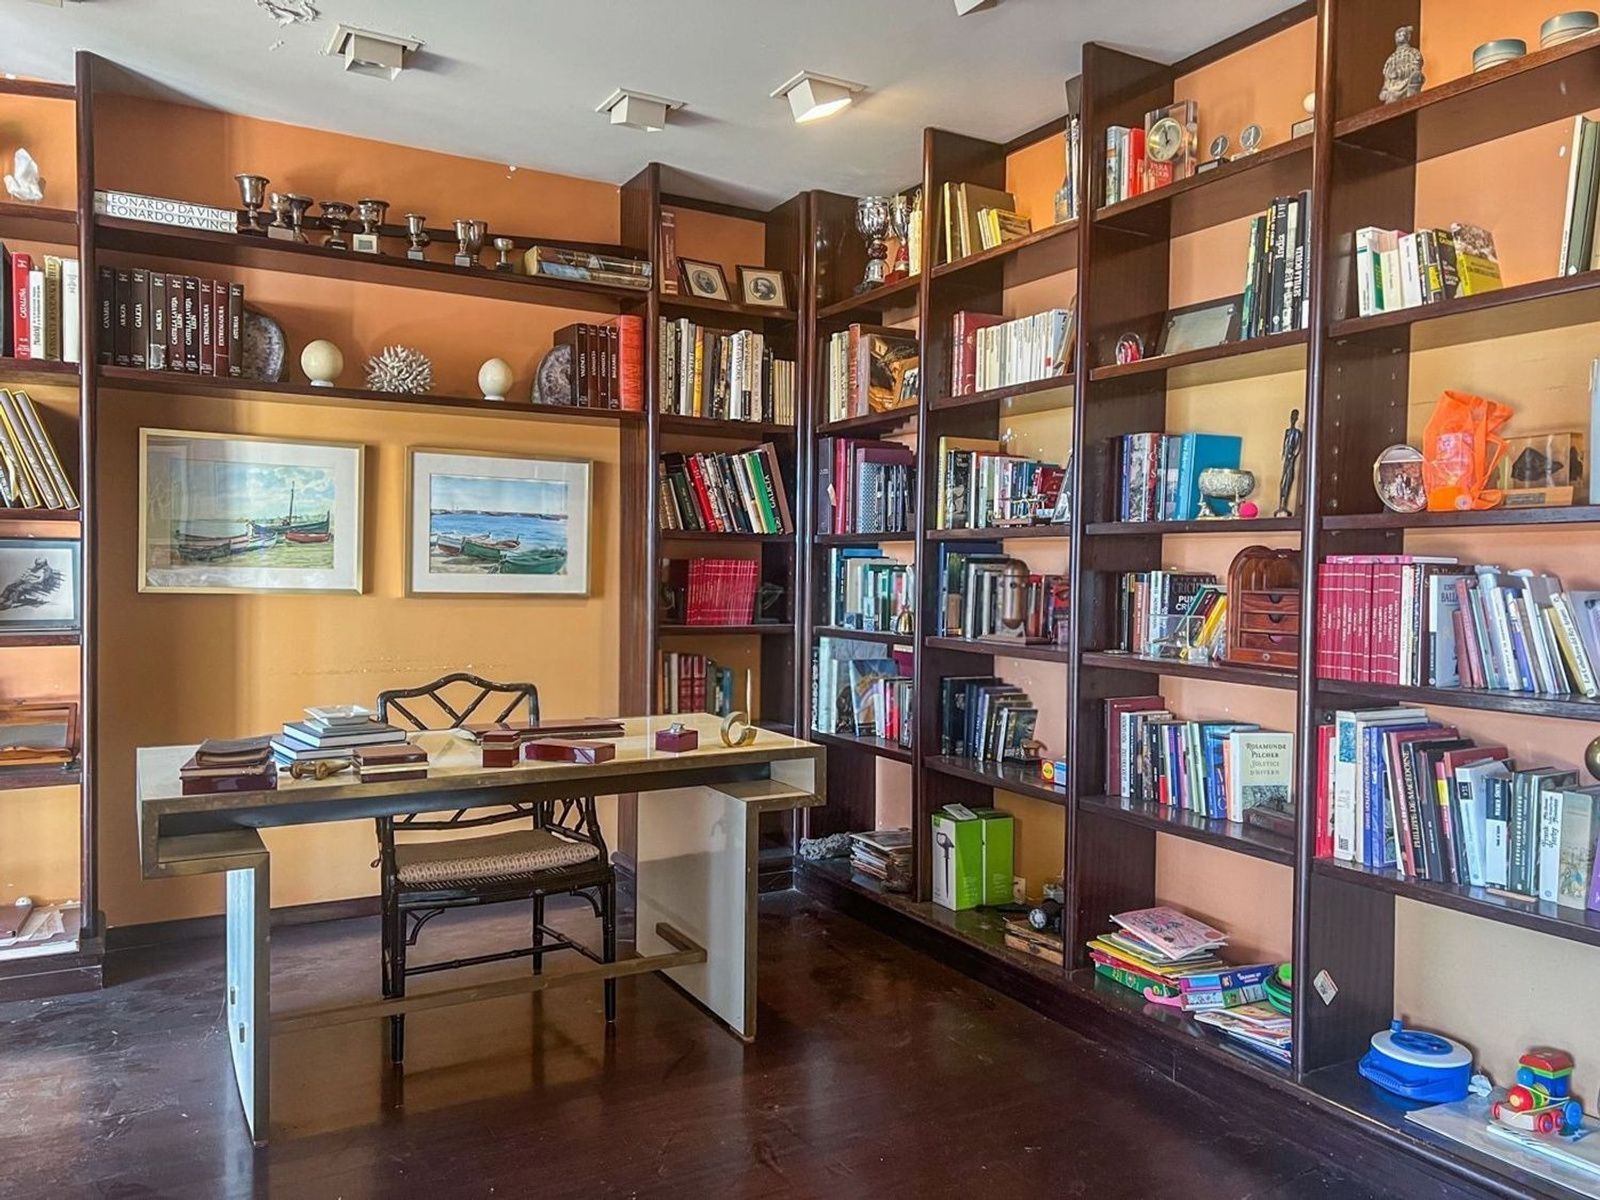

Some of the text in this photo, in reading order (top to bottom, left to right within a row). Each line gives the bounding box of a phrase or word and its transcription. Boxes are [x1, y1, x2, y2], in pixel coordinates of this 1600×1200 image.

[178, 203, 196, 214] DA
[197, 205, 233, 221] VINCI
[178, 214, 195, 225] DA
[195, 217, 233, 232] VINCI
[1275, 233, 1286, 259] India
[1293, 270, 1302, 297] SEVILLA
[155, 309, 163, 331] MURCIA
[764, 474, 777, 509] GALICIA
[1245, 742, 1287, 751] ROSAMUNDE
[1251, 750, 1280, 758] PILCHER
[1407, 799, 1416, 813] DE
[1408, 814, 1421, 849] PHILIPPE
[1541, 826, 1550, 848] Frank
